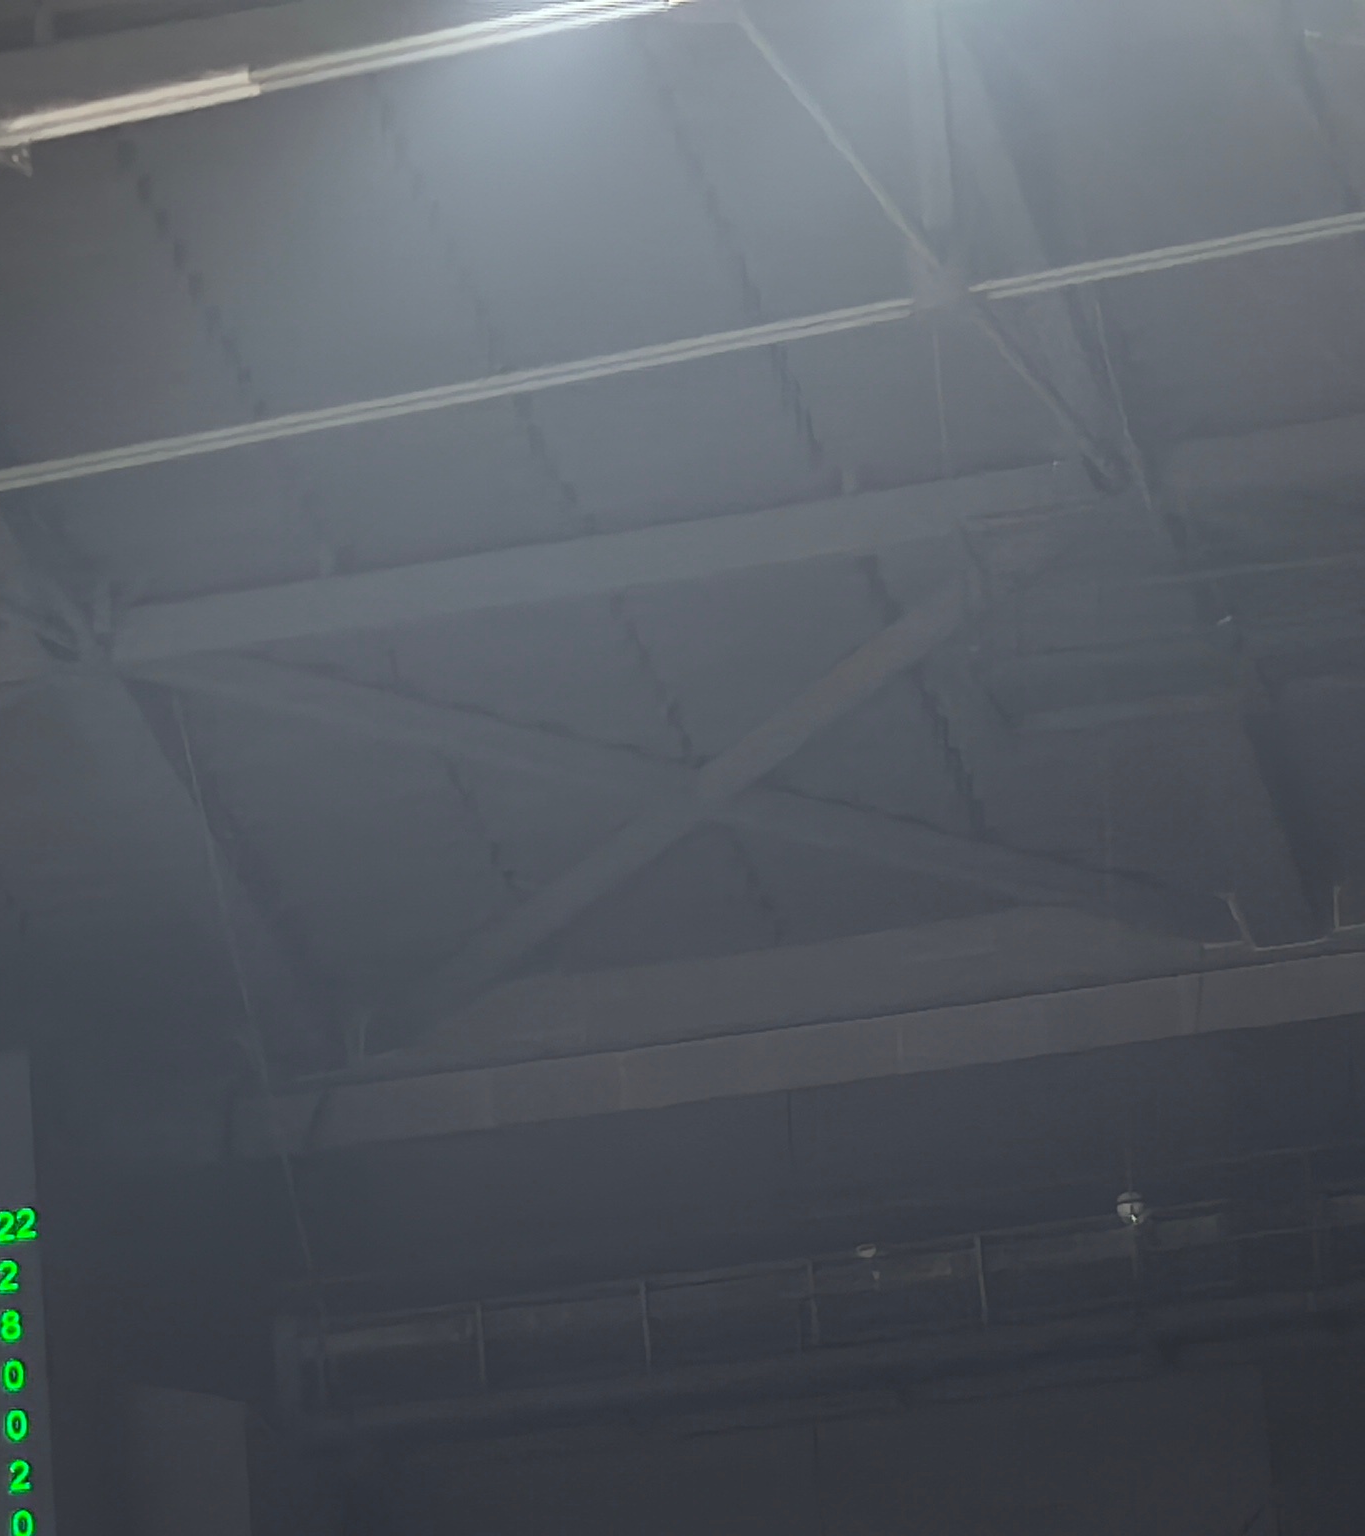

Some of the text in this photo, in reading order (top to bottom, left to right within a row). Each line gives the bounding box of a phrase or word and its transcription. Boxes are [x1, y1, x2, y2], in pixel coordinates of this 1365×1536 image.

[0, 1309, 24, 1344] 8
[2, 1359, 26, 1393] 0
[5, 1409, 29, 1443] 0
[9, 1459, 32, 1495] 2
